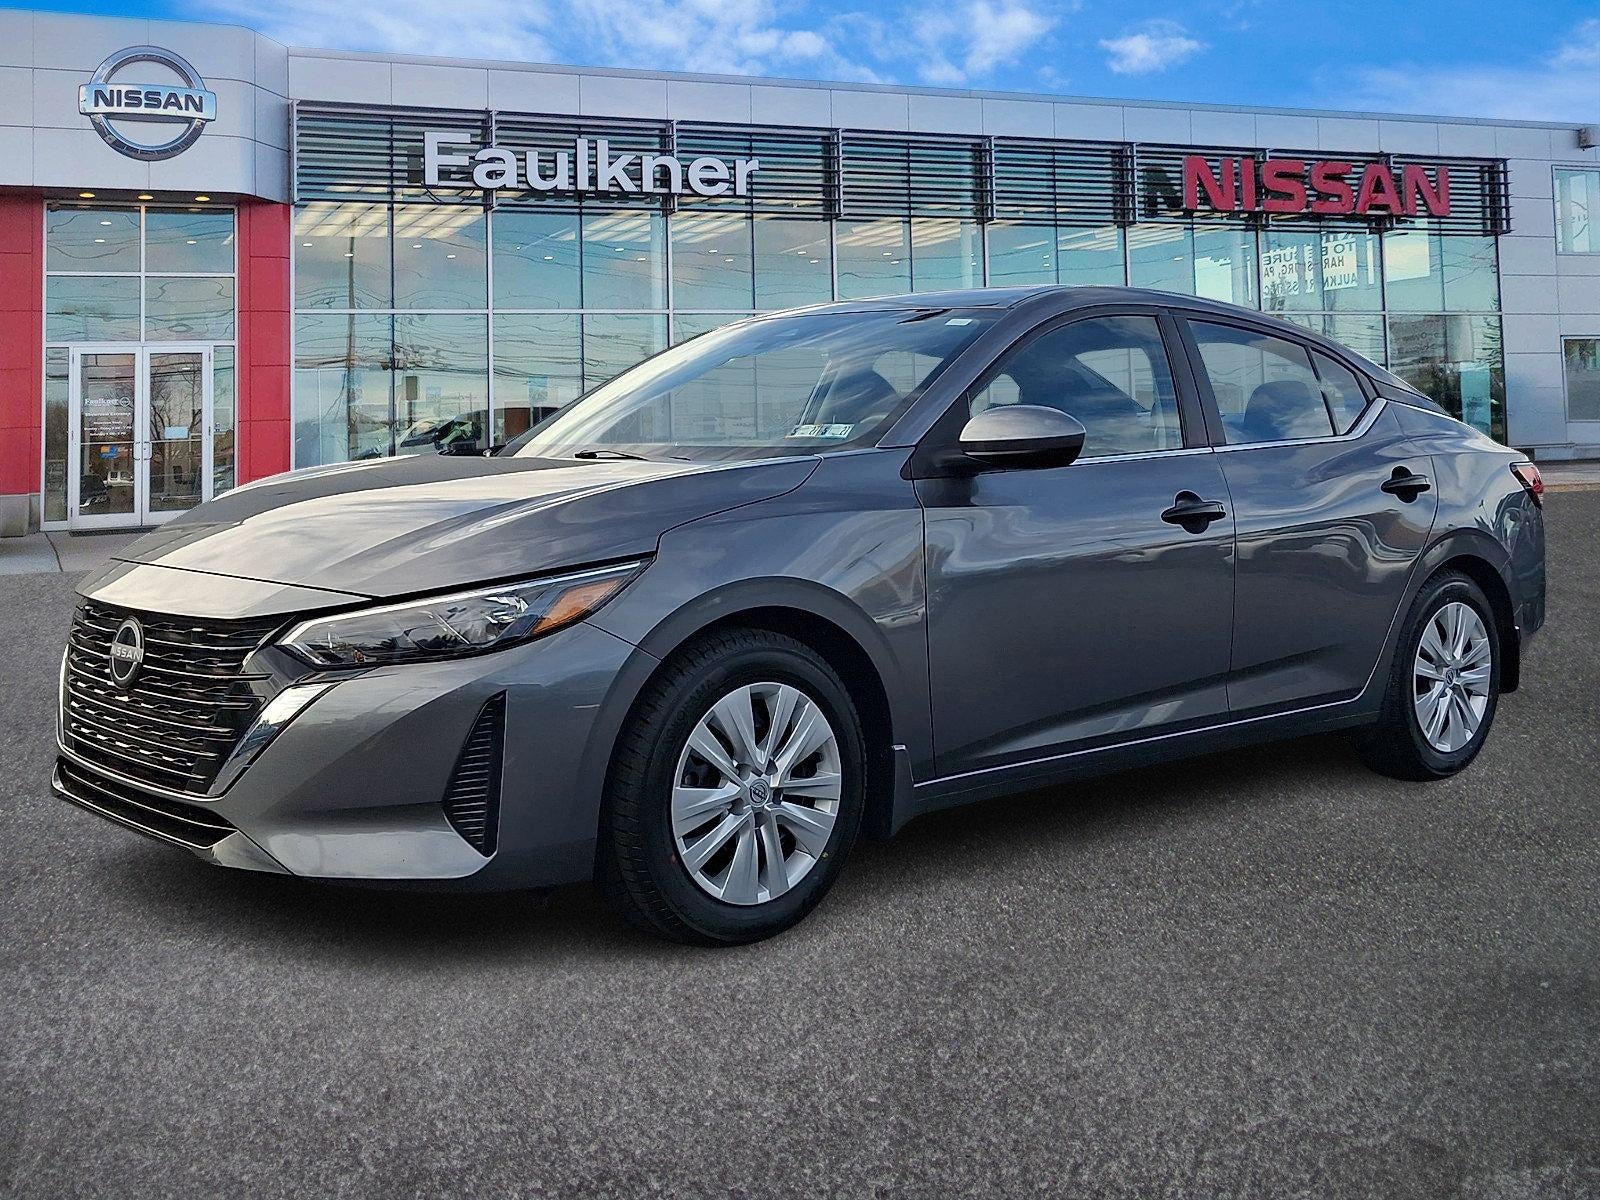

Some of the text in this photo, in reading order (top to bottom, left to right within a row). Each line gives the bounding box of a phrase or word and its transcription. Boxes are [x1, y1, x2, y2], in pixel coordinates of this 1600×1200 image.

[94, 89, 203, 113] NISSAN
[423, 131, 759, 196] Faulkner
[1183, 155, 1450, 216] NISSAN
